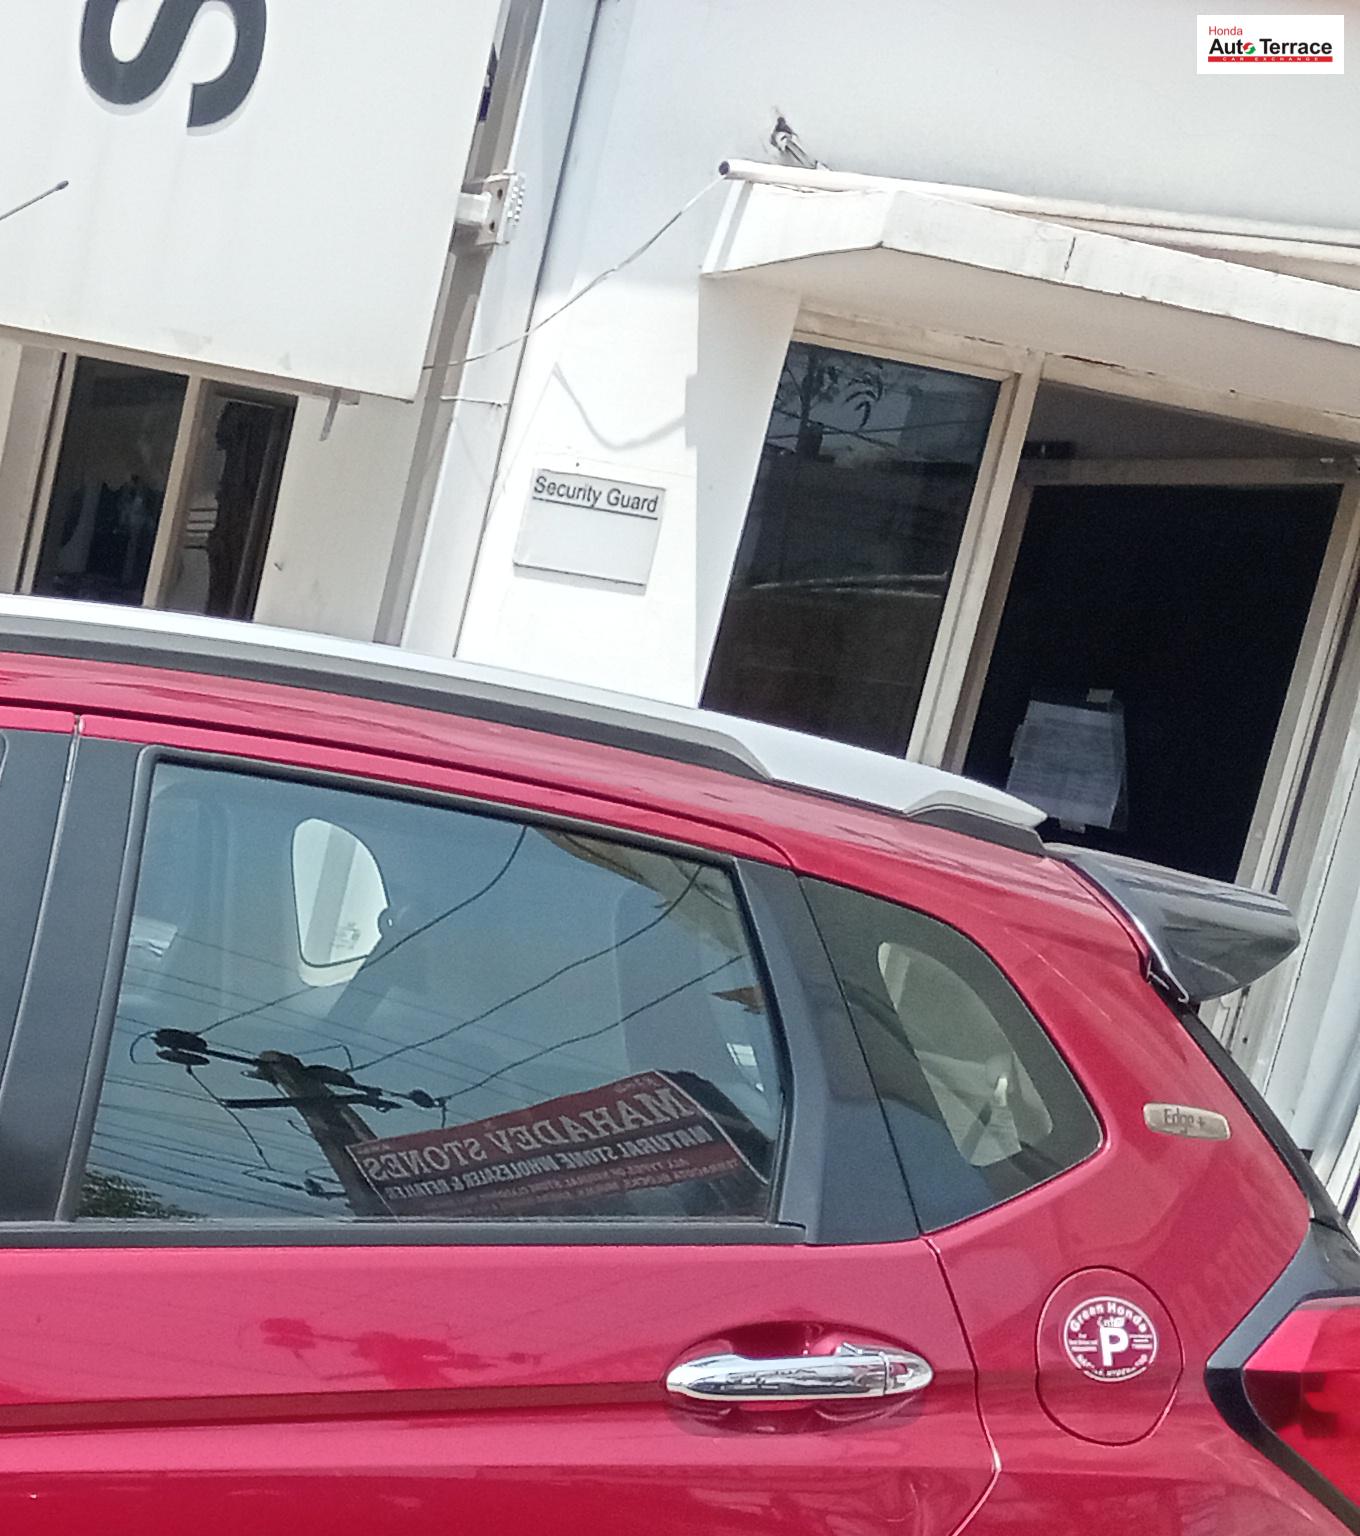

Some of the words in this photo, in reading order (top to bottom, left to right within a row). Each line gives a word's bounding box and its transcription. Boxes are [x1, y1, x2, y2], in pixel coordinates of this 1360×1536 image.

[79, 0, 267, 128] S
[534, 475, 602, 508] Security
[606, 487, 659, 513] Guard
[1069, 1303, 1104, 1332] Green
[1107, 1301, 1147, 1333] Honda
[1100, 1328, 1129, 1367] P
